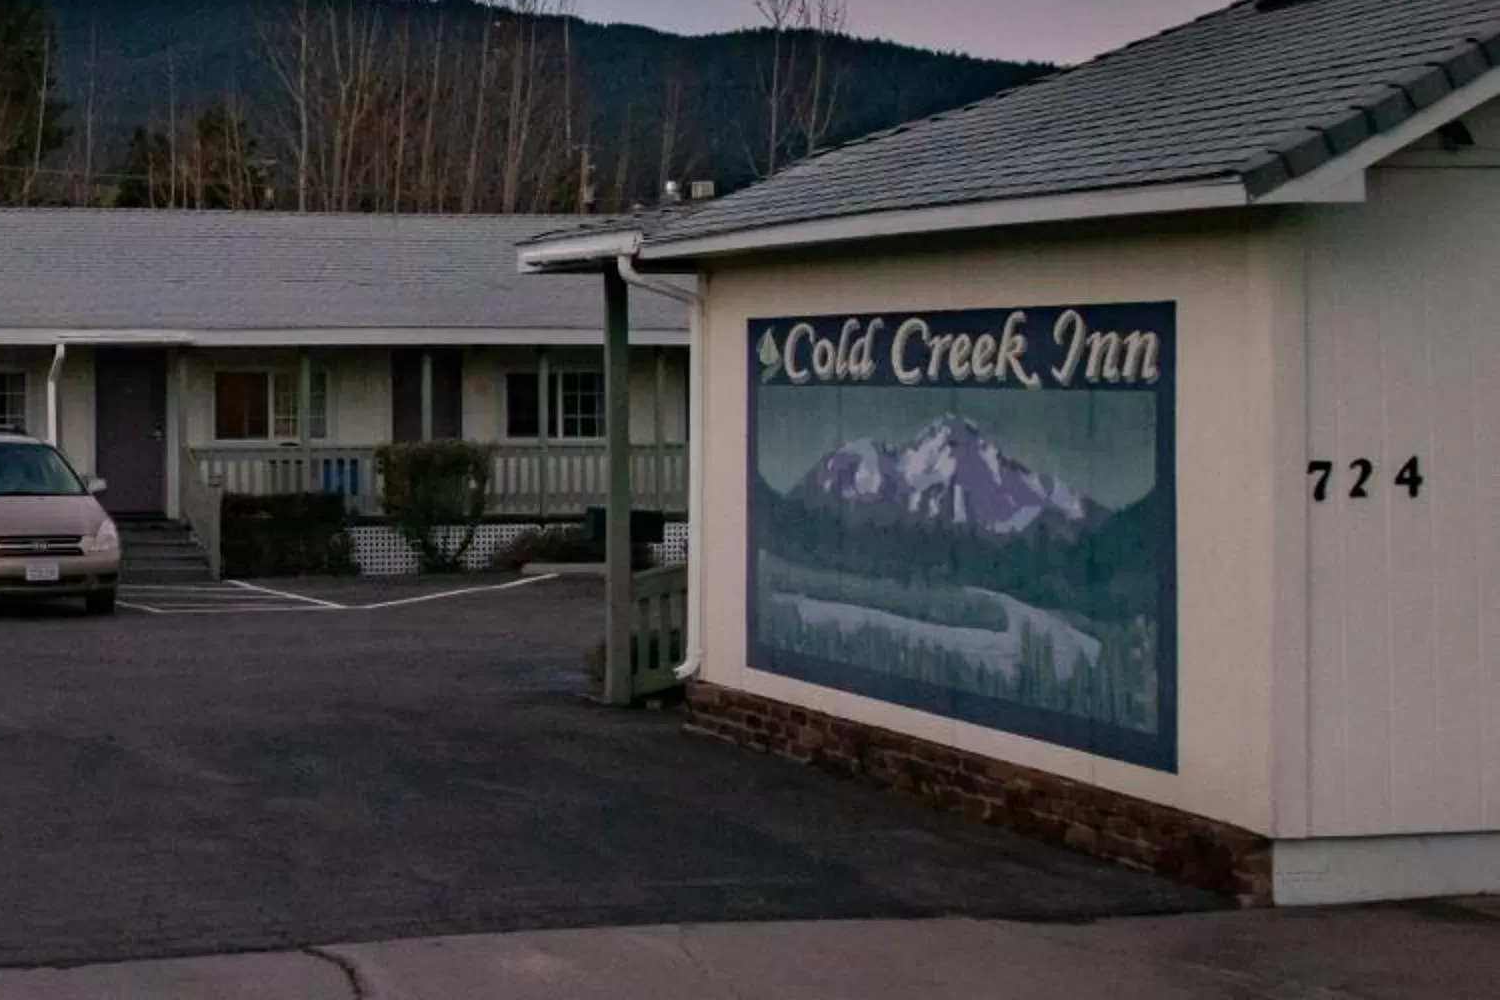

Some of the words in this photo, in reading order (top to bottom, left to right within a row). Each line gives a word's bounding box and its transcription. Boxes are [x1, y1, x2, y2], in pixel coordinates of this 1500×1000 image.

[783, 319, 884, 382] Cold
[892, 312, 1041, 389] Creek
[1051, 309, 1160, 386] Inn
[1307, 455, 1424, 502] 724
